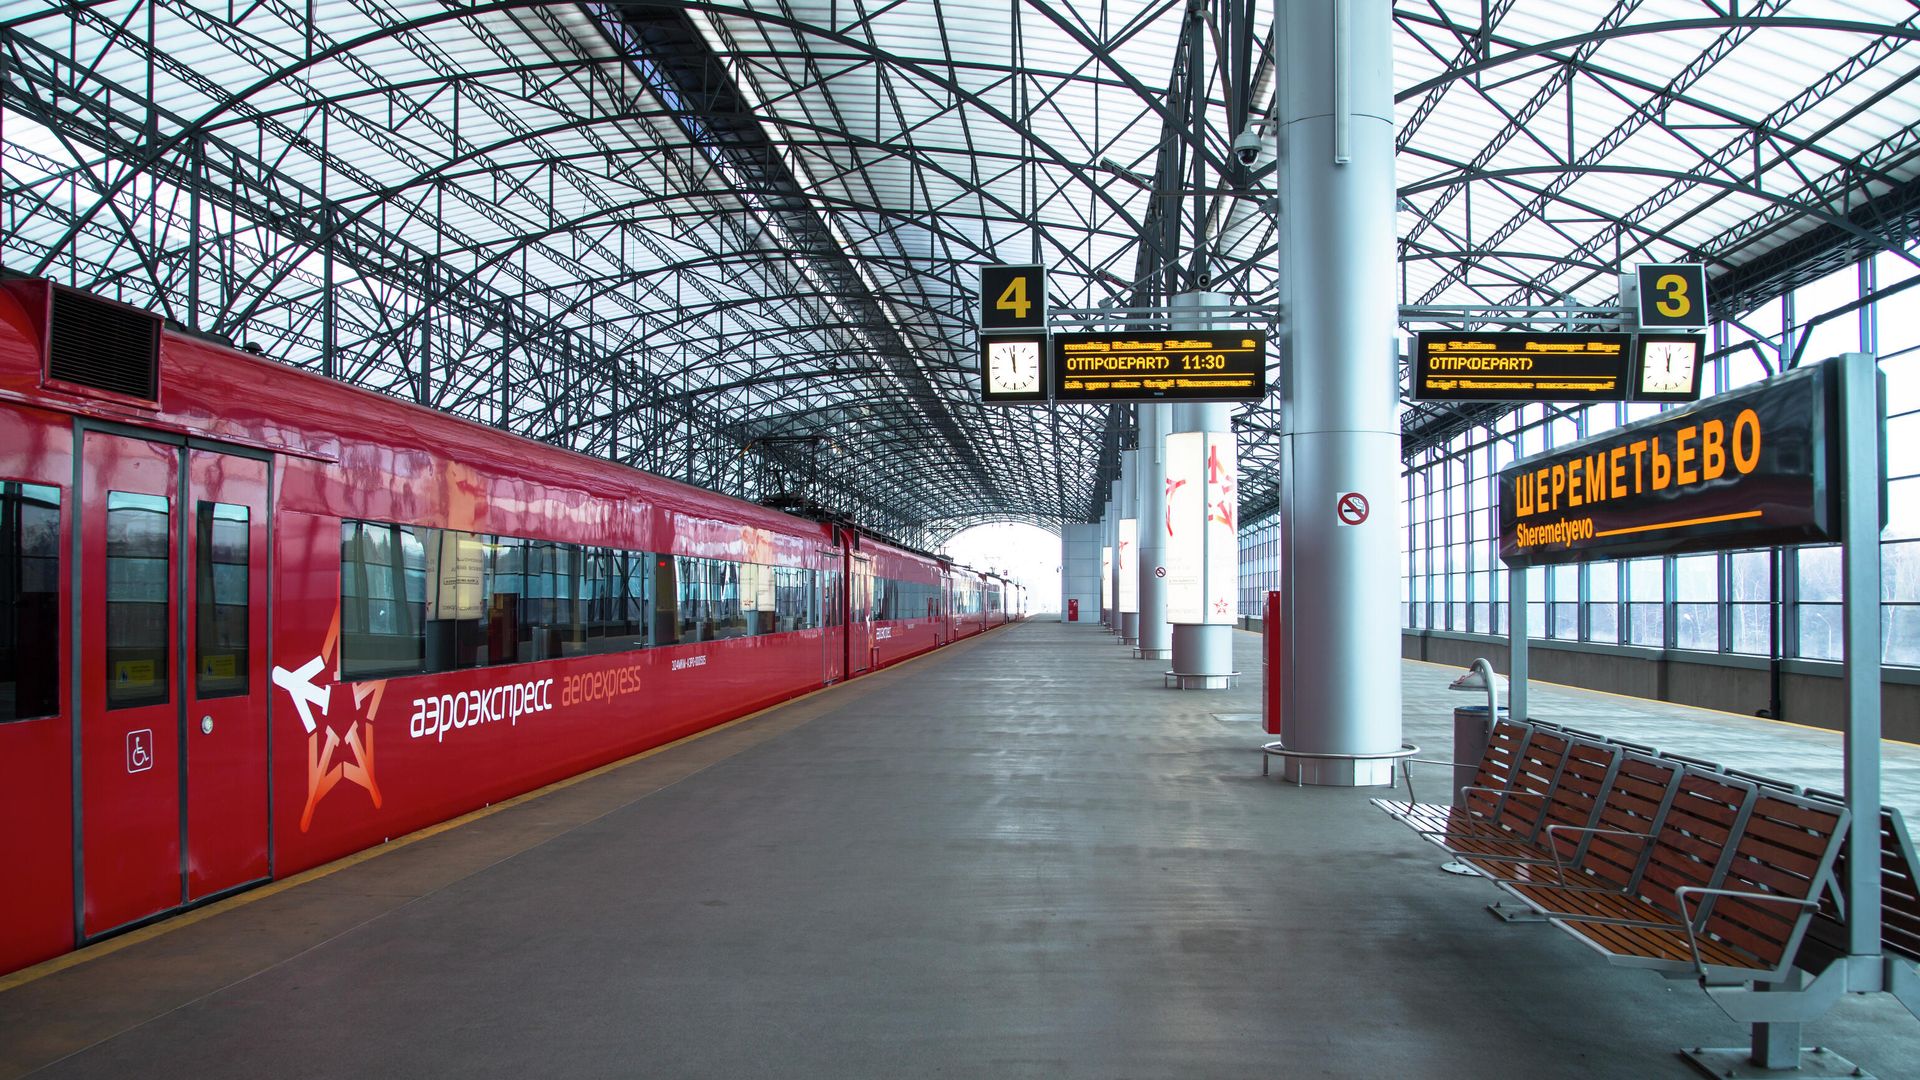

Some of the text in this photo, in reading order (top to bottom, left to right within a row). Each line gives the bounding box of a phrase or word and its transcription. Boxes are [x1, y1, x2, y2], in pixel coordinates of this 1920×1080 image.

[996, 276, 1031, 319] 4
[1656, 274, 1691, 318] 3
[1181, 354, 1226, 370] 11:30
[1515, 408, 1762, 518] ШЕРЕМЕТЬЕВО
[1516, 517, 1594, 548] Sheremetyevo
[561, 664, 642, 707] aeroexpress
[409, 678, 554, 743] аэроэкспресс
